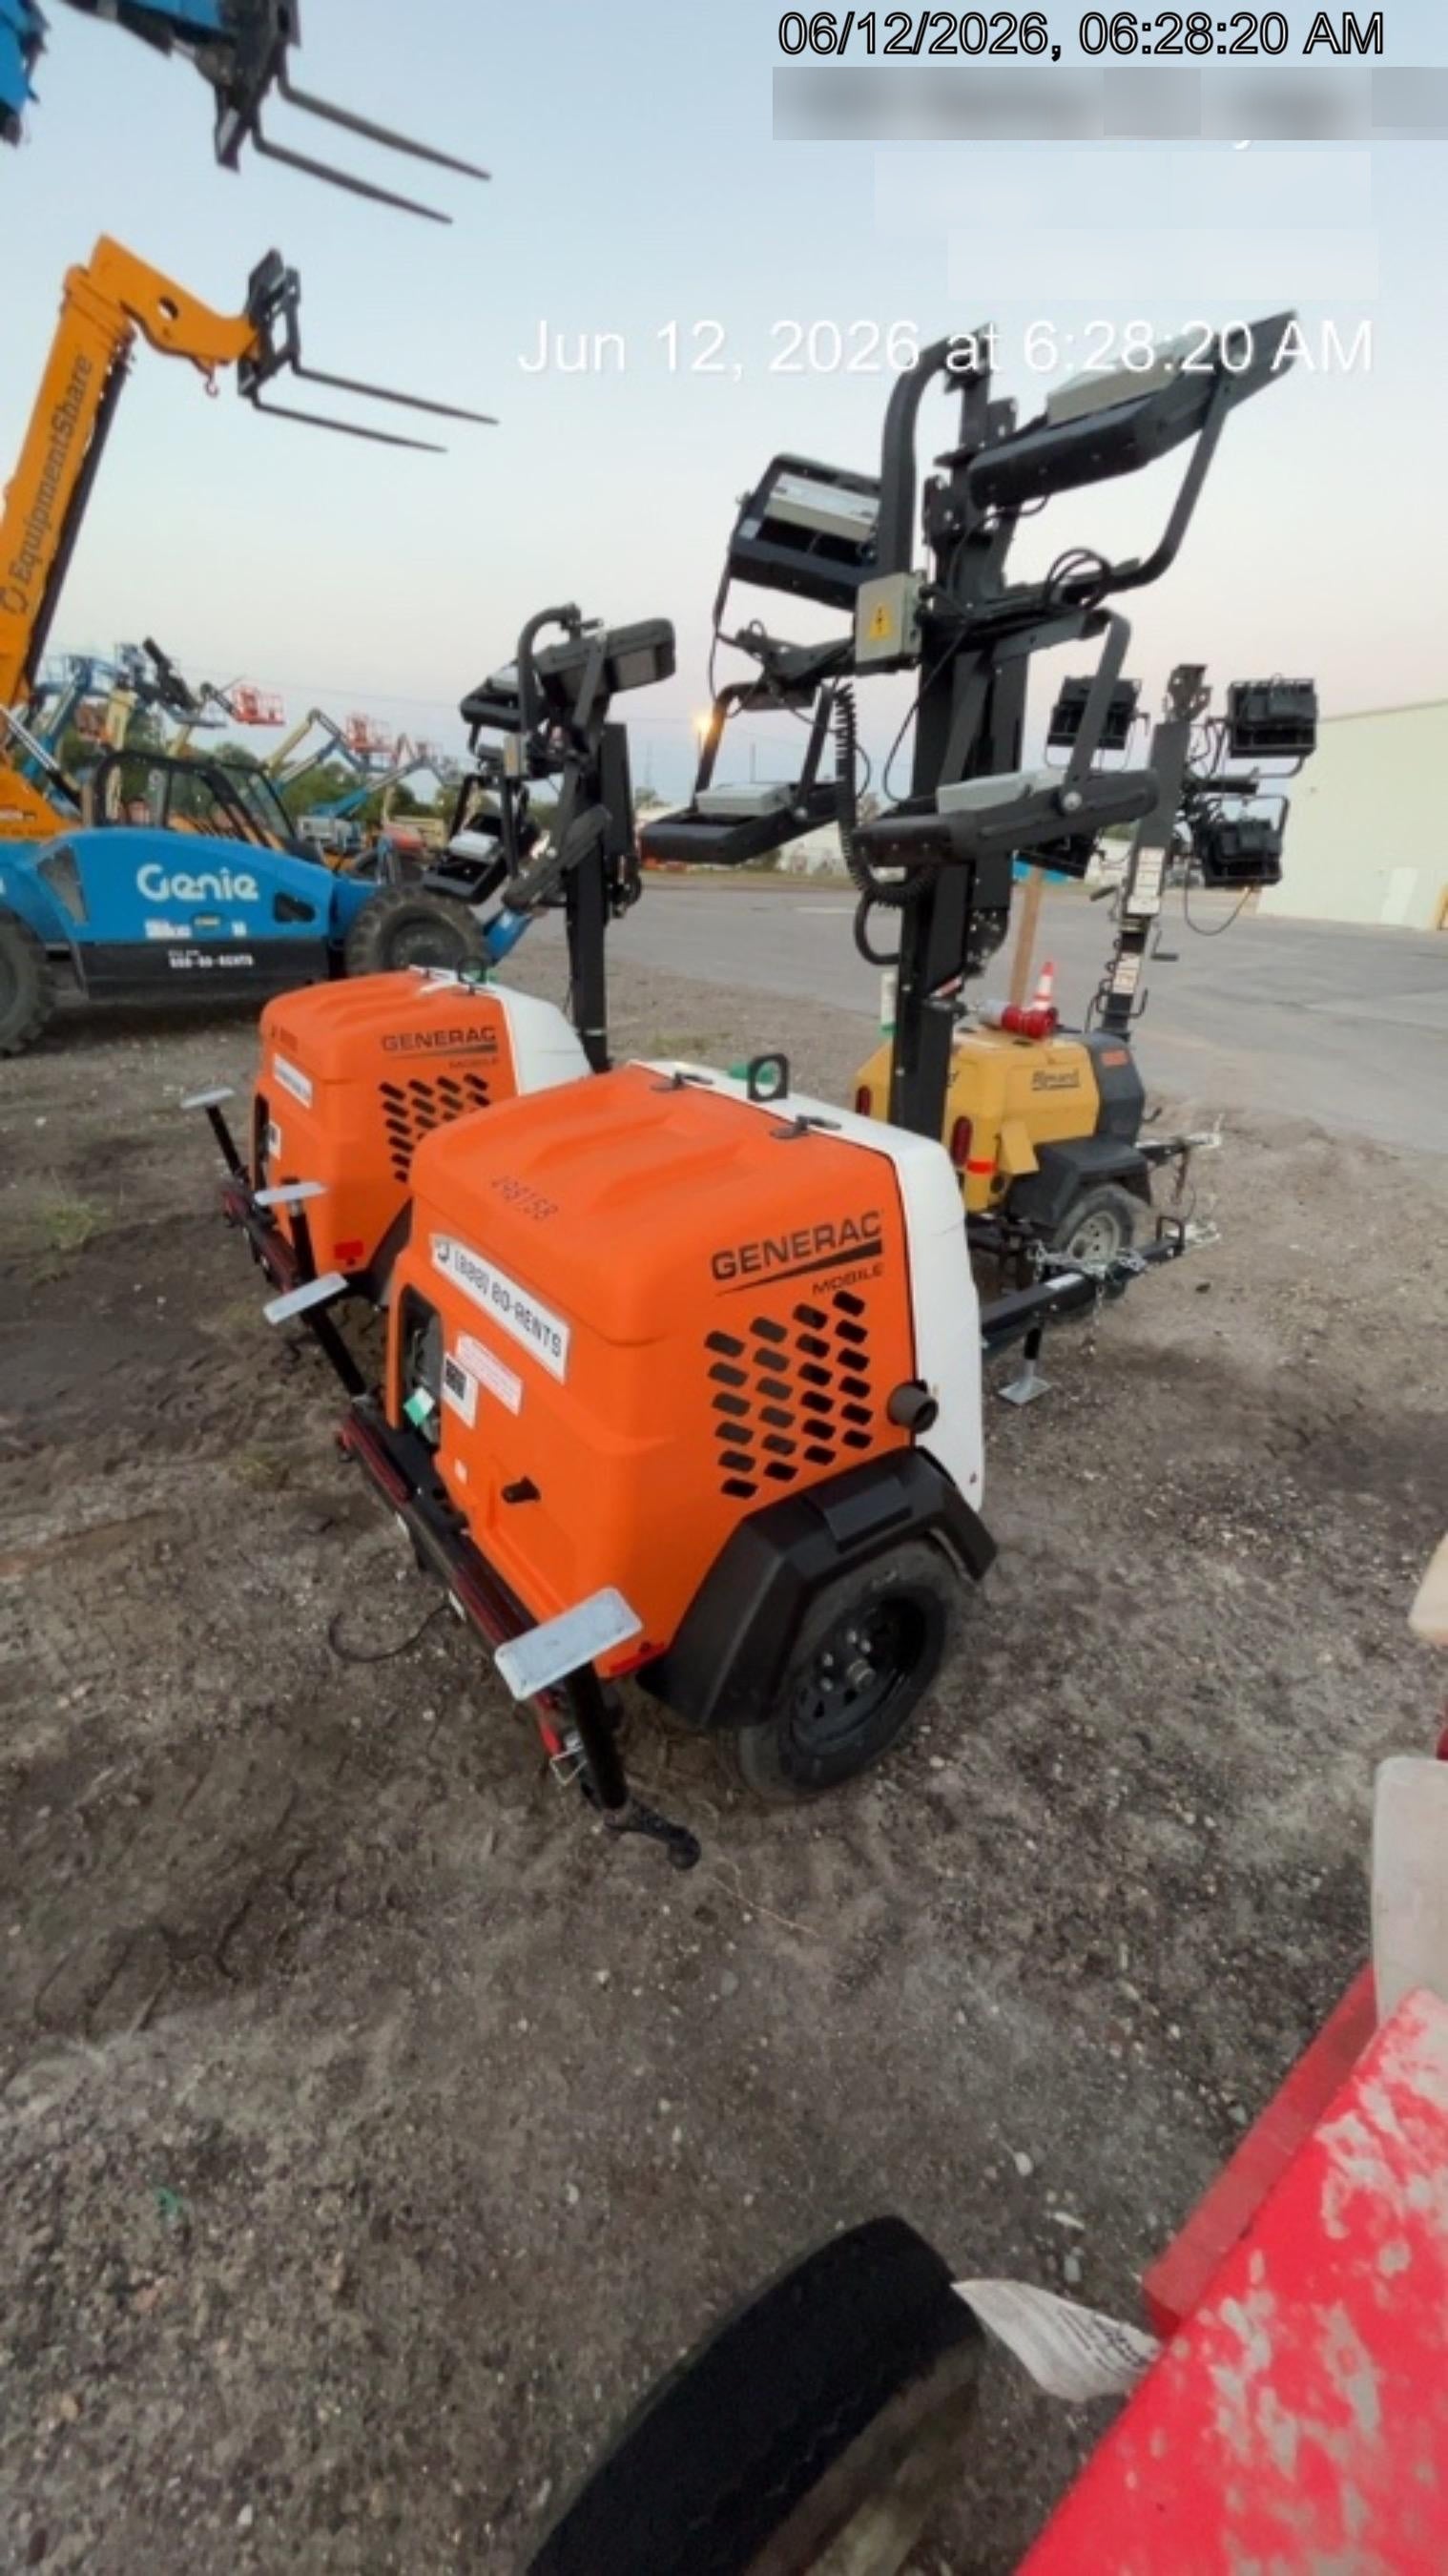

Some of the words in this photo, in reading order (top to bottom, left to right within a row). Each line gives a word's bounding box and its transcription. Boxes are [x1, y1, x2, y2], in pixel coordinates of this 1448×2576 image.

[10, 354, 93, 585] EquipmentShare
[136, 863, 259, 902] Genie
[382, 1027, 496, 1051] GENERAC
[712, 1211, 881, 1280] GENERAC
[812, 1262, 884, 1295] MOBILE
[491, 1281, 562, 1358] 80-RENTS
